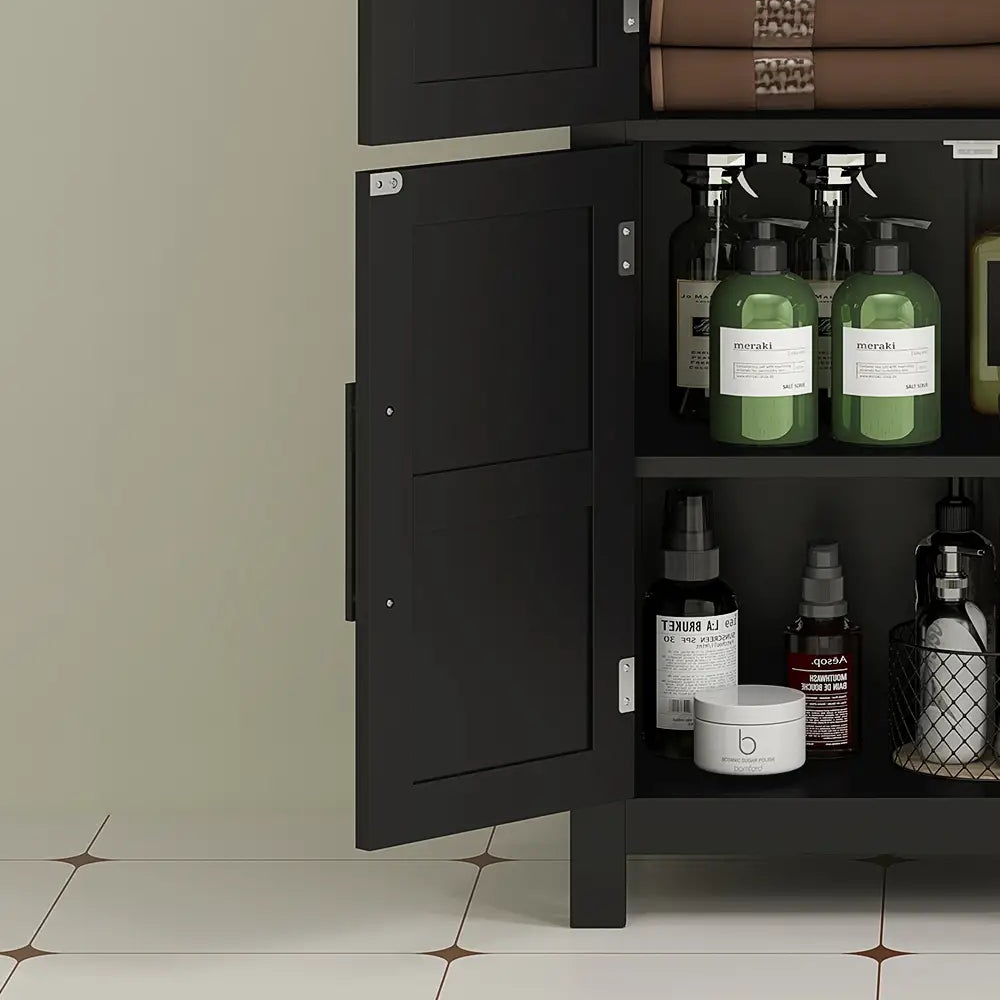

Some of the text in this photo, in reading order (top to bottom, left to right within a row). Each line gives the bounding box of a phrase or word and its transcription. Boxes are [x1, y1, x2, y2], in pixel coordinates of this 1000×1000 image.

[734, 342, 773, 350] meraki
[857, 342, 896, 350] meraki
[738, 728, 757, 756] b
